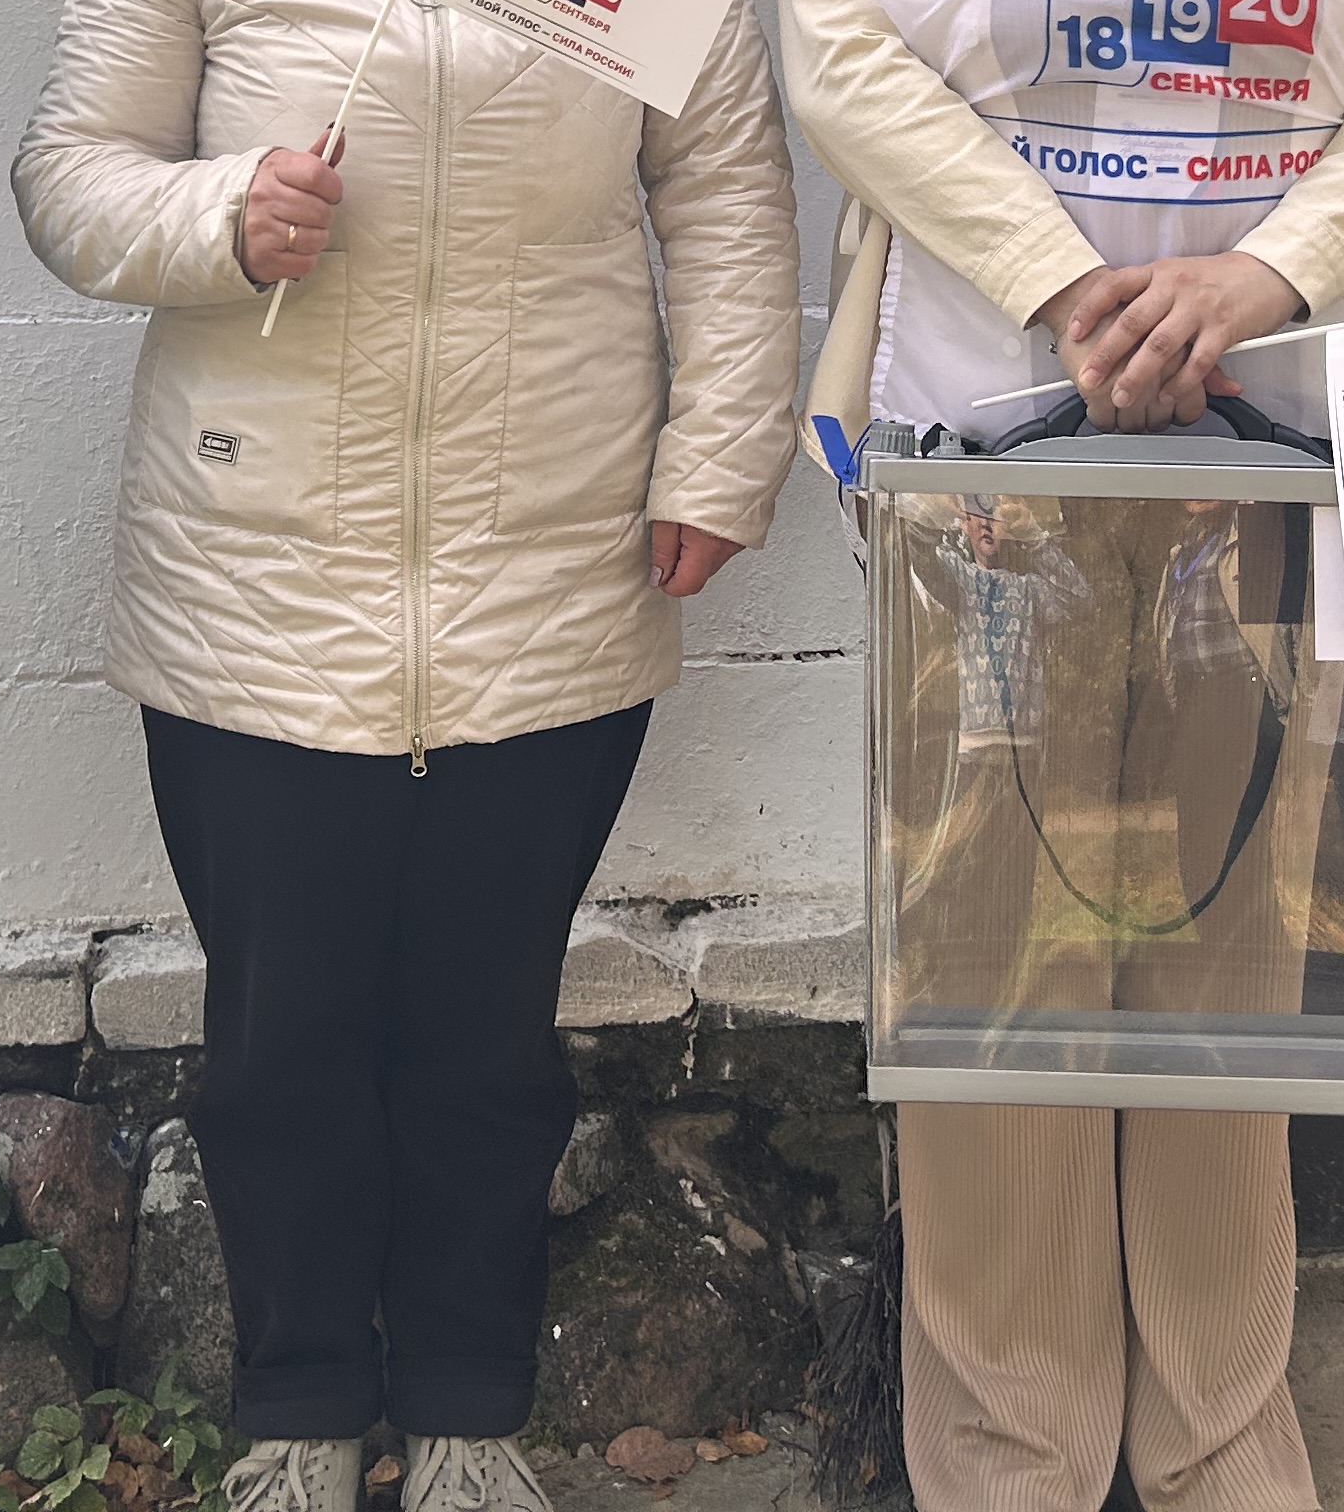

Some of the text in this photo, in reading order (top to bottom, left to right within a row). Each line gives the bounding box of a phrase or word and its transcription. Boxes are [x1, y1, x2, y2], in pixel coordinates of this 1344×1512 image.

[552, 0, 612, 34] СЕНТЯБРЯ
[501, 9, 541, 34] ГОЛОС
[552, 32, 584, 56] СИЛА
[585, 47, 636, 79] РОССИИ!
[1056, 16, 1127, 70] 18
[1150, 71, 1310, 102] СЕНТЯБРЯ
[1040, 145, 1147, 180] ГОЛОС
[1187, 154, 1273, 182] СИЛА
